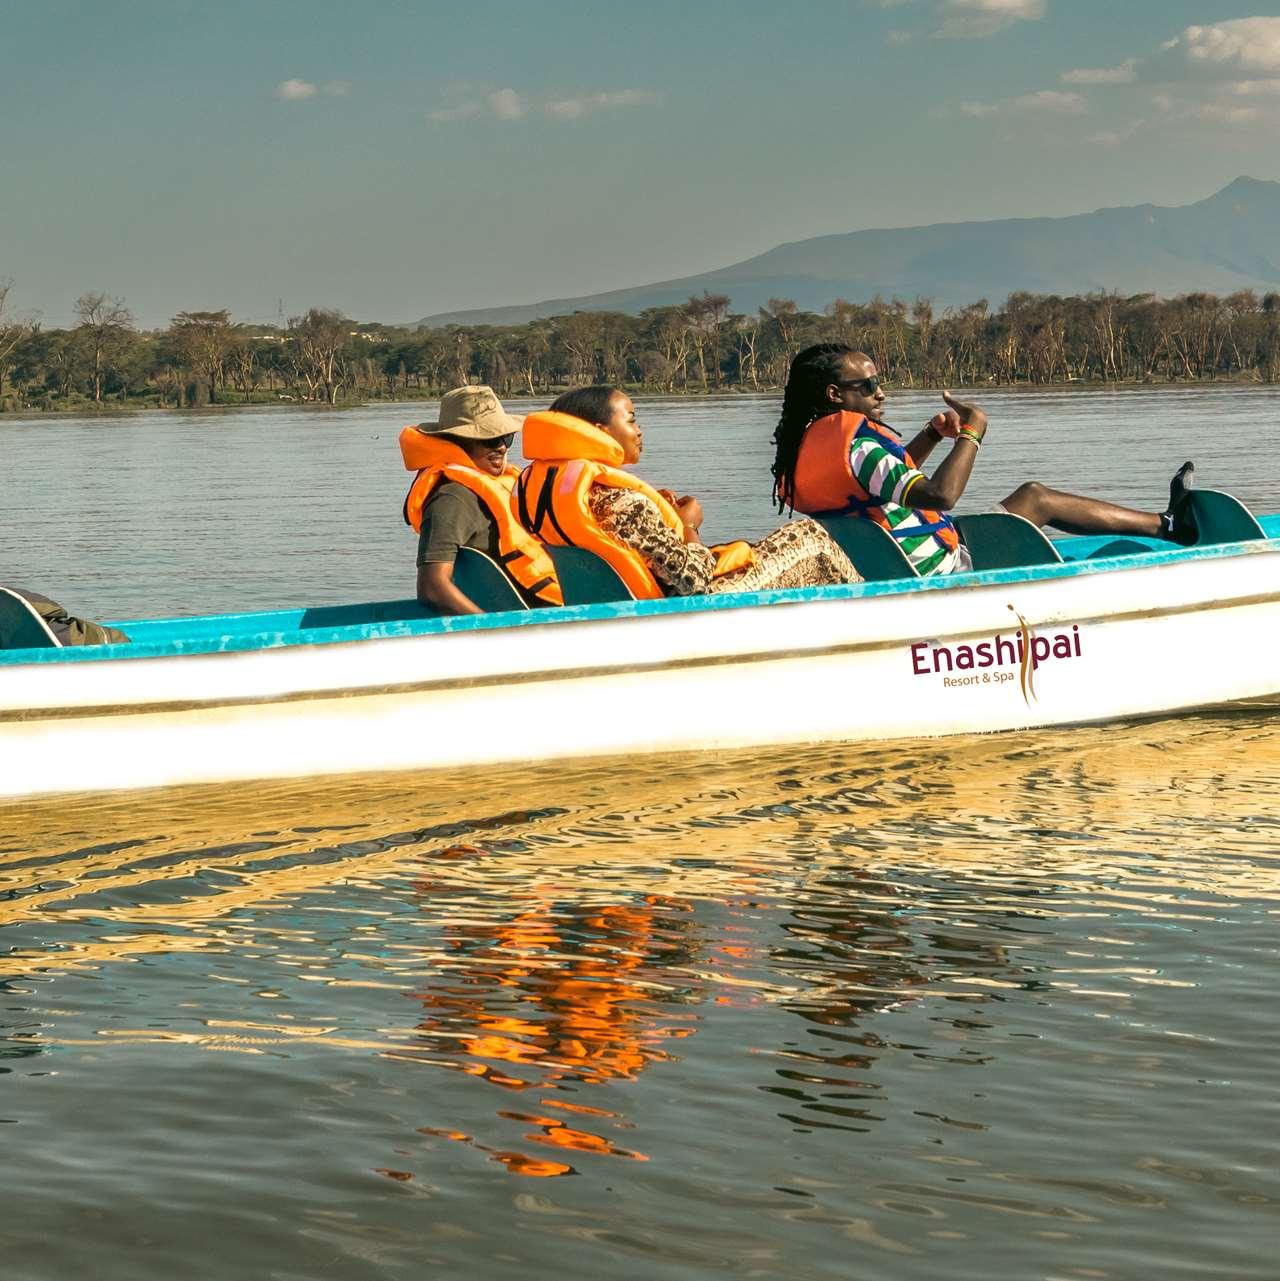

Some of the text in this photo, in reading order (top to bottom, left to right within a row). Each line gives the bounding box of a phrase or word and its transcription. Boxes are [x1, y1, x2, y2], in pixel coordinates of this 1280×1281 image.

[910, 624, 1082, 675] Enashipai
[943, 671, 1015, 688] Resort & Spa
